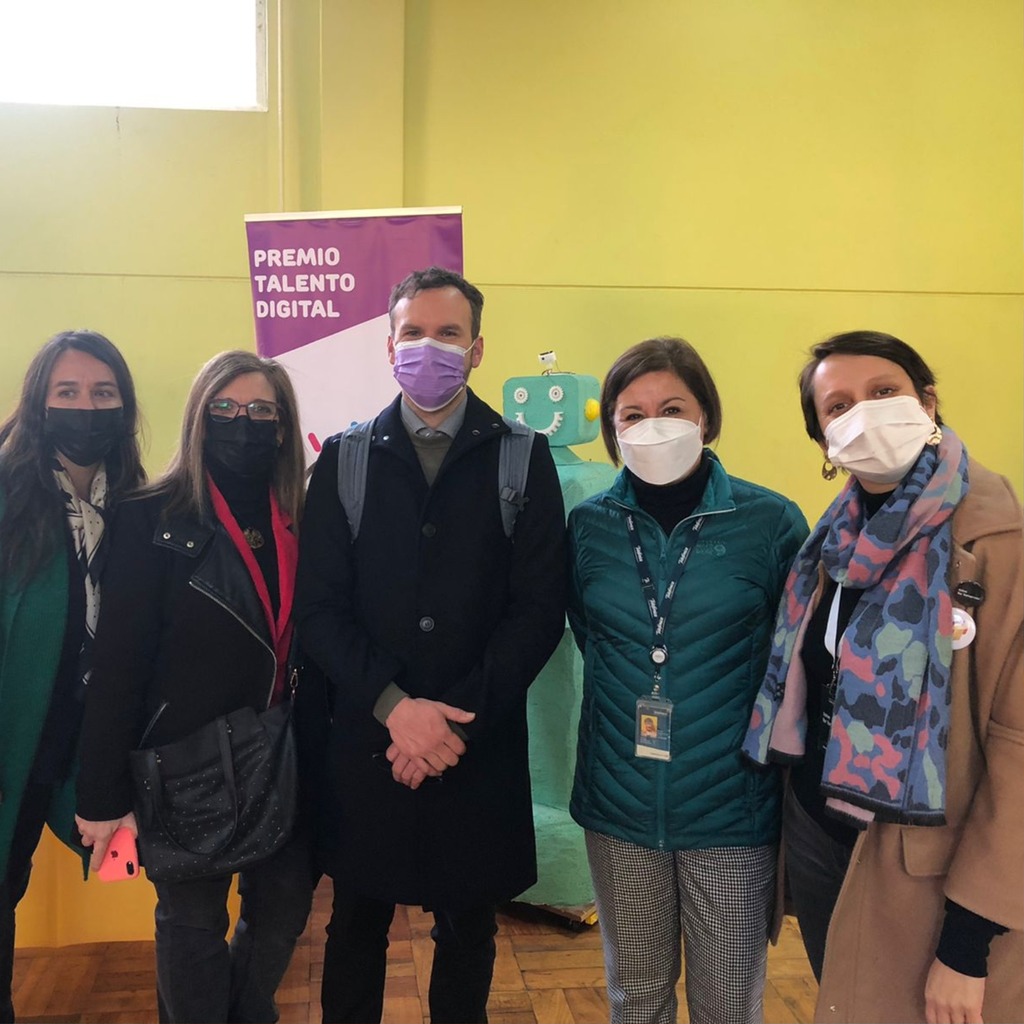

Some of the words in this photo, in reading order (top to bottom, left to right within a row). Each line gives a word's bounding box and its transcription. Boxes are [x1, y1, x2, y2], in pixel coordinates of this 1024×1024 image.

[254, 247, 341, 268] PREMIO
[254, 273, 356, 293] TALENTO
[256, 299, 340, 318] DIGITAL
